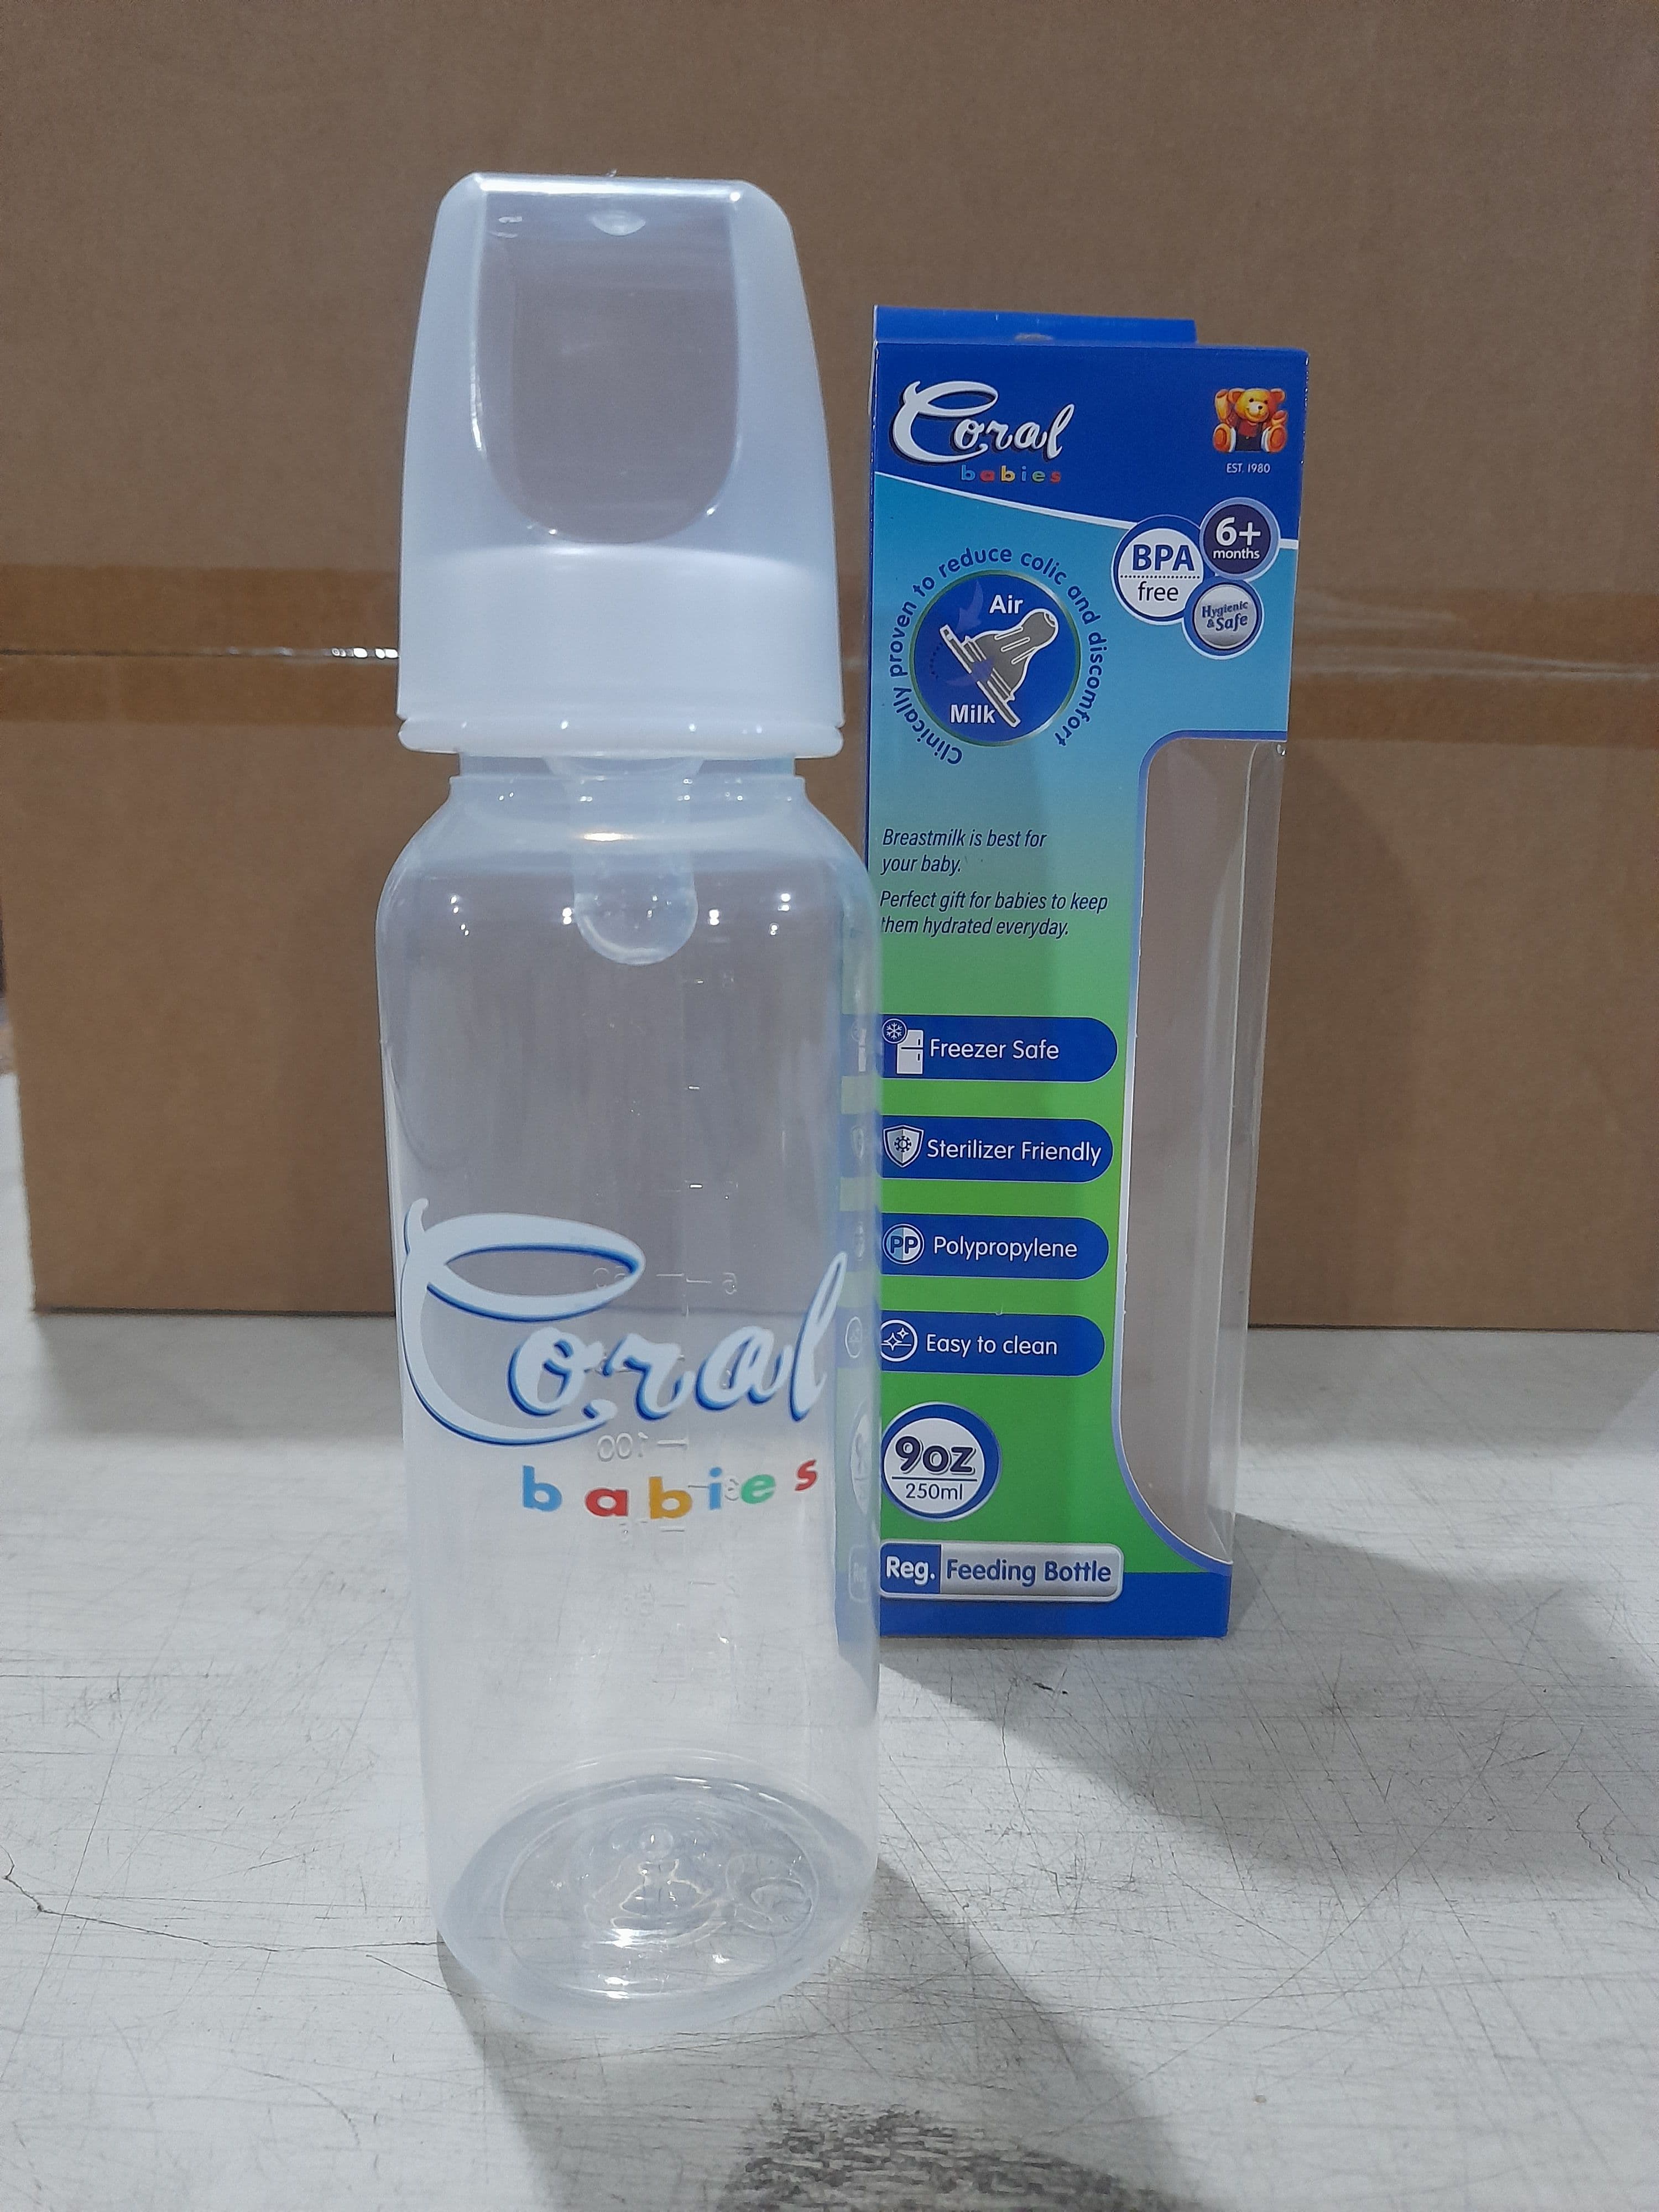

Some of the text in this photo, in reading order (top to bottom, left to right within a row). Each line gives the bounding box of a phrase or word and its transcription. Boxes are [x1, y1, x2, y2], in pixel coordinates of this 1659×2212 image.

[890, 380, 1074, 464] Coral
[961, 465, 1060, 483] babies
[1225, 462, 1271, 474] EST. 1980
[1216, 517, 1261, 546] 6+
[1133, 544, 1194, 571] BPA
[1213, 548, 1261, 560] months
[1138, 581, 1179, 601] free
[989, 594, 1024, 614] Air
[1201, 600, 1249, 618] Hygienic
[889, 547, 1108, 764] Clinically proven to reduce colic and discomfort
[950, 703, 996, 723] Milk
[882, 828, 1047, 847] Breastmilk is best for
[880, 854, 962, 876] your baby.
[880, 890, 1108, 914] Perfect gift for babies to keep
[922, 916, 993, 937] hydrated
[995, 917, 1068, 939] everyday.
[930, 1039, 1059, 1060] Freezer Safe
[927, 1139, 1102, 1167] Sterilizer Friendly
[890, 1235, 918, 1254] PP
[933, 1235, 1078, 1261] Polypropylene
[401, 1198, 848, 1447] Coral
[926, 1333, 1058, 1358] Easy to clean
[895, 1435, 976, 1475] 9oz
[521, 1458, 818, 1520] babies
[905, 1483, 963, 1500] 250ml
[885, 1556, 936, 1586] Reg.
[946, 1558, 1036, 1587] Feeding
[1044, 1560, 1112, 1582] Bottle
